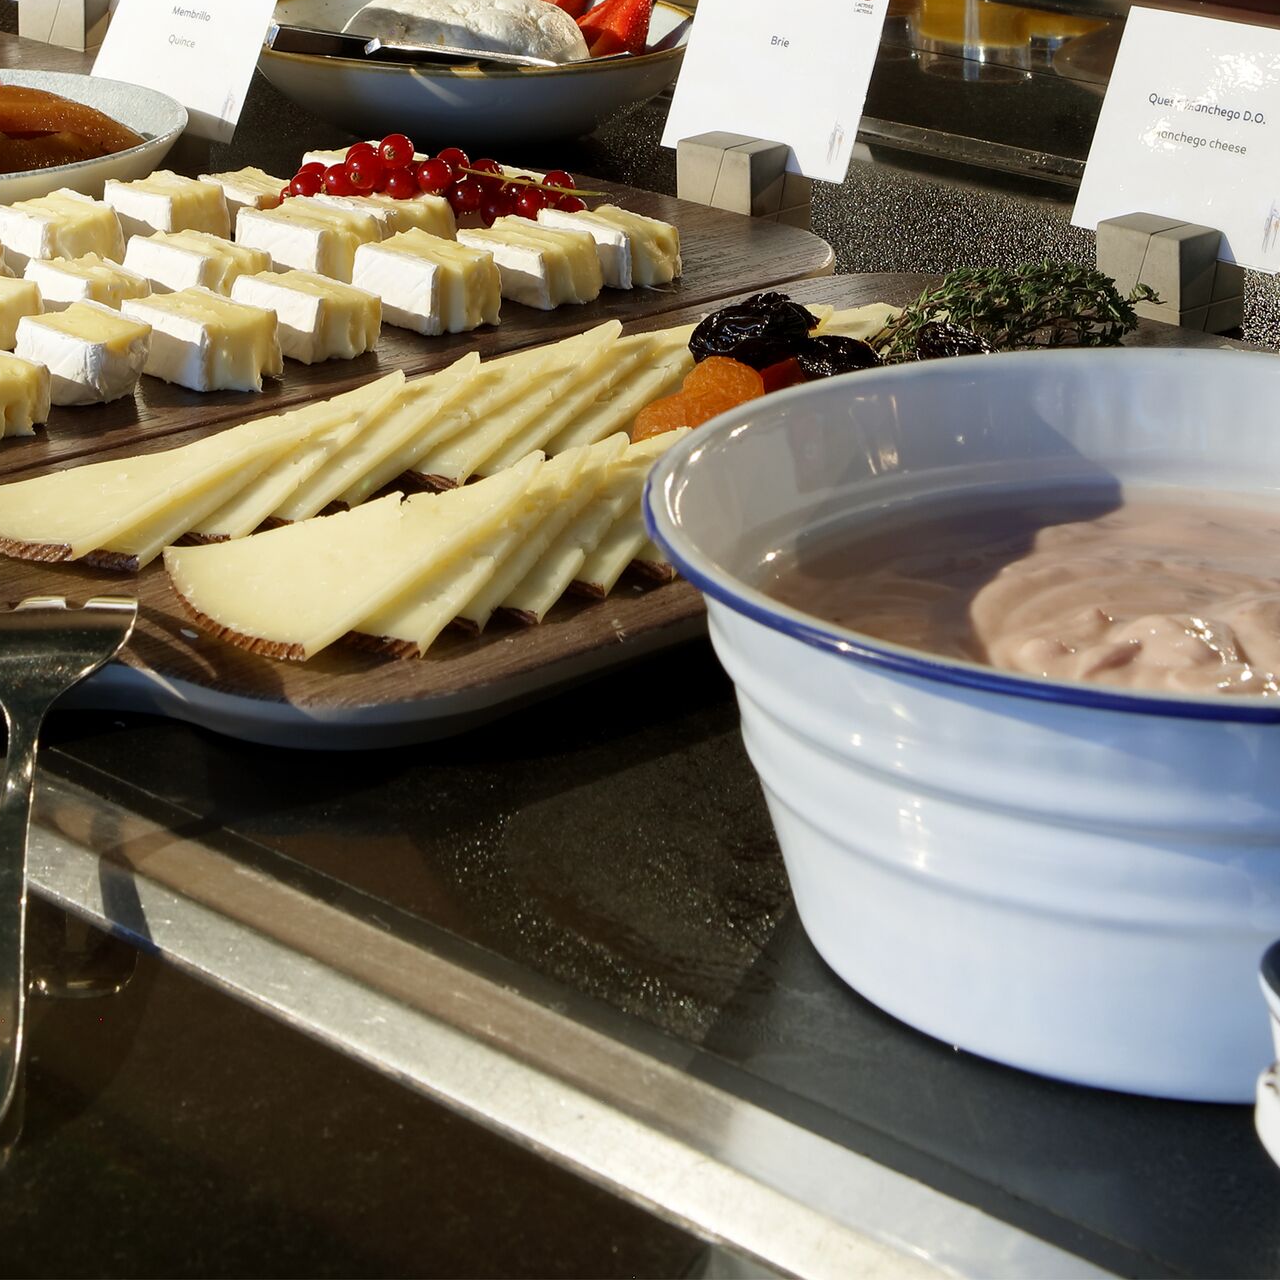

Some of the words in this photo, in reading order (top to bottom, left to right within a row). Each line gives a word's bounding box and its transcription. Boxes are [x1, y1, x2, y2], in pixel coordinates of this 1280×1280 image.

[172, 5, 211, 22] Membrillo
[168, 34, 196, 48] Quince
[770, 35, 790, 48] Brie
[1243, 110, 1266, 125] D.O.
[1156, 131, 1207, 148] anchego
[1209, 138, 1247, 155] cheese
